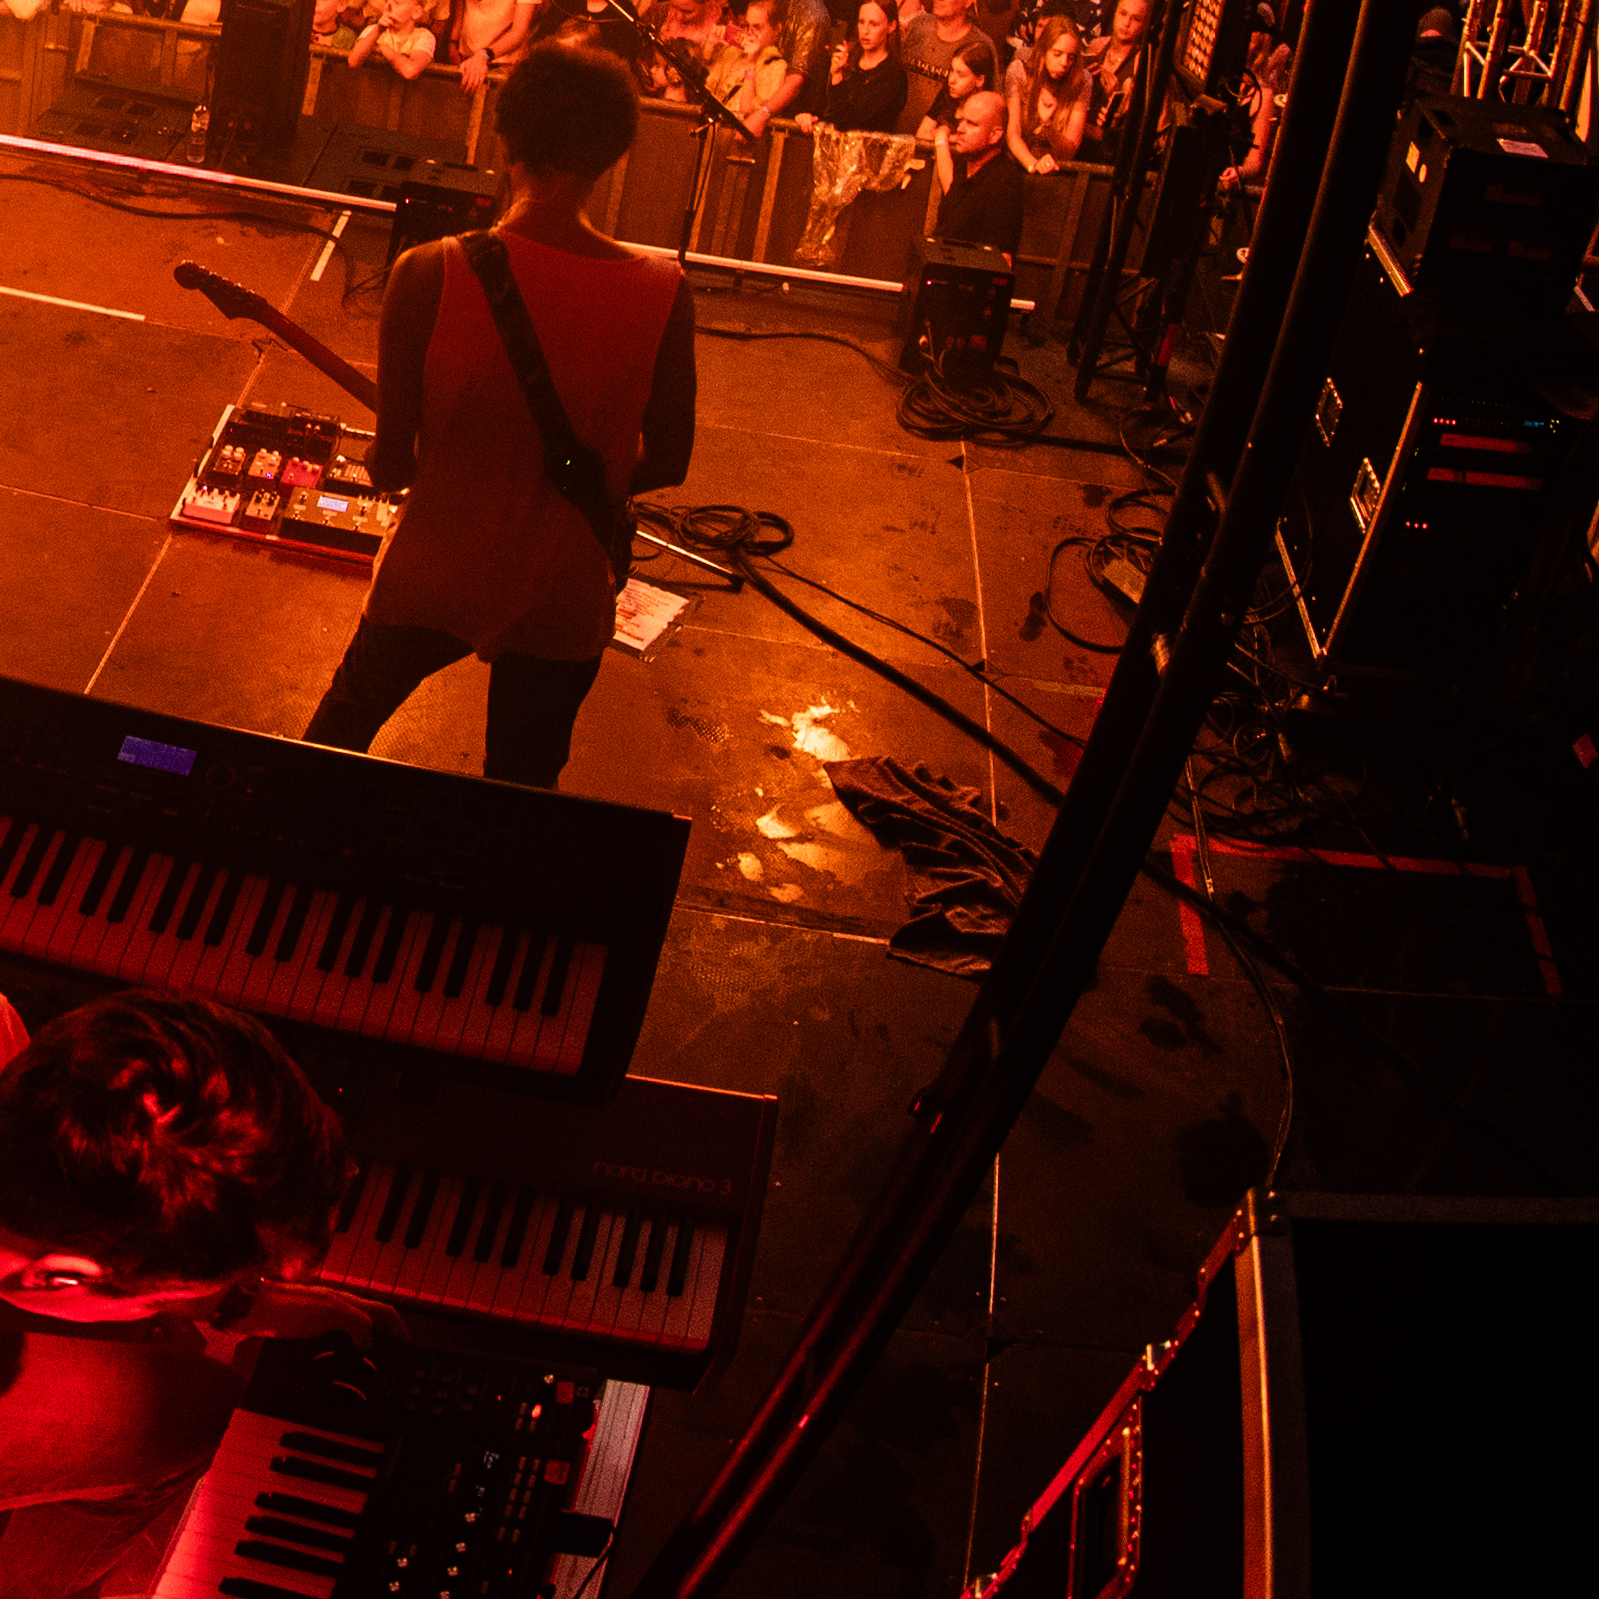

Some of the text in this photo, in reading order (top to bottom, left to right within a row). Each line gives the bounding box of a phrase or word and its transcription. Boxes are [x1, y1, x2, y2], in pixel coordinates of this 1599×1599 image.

[592, 1161, 732, 1196] nord piano 3
